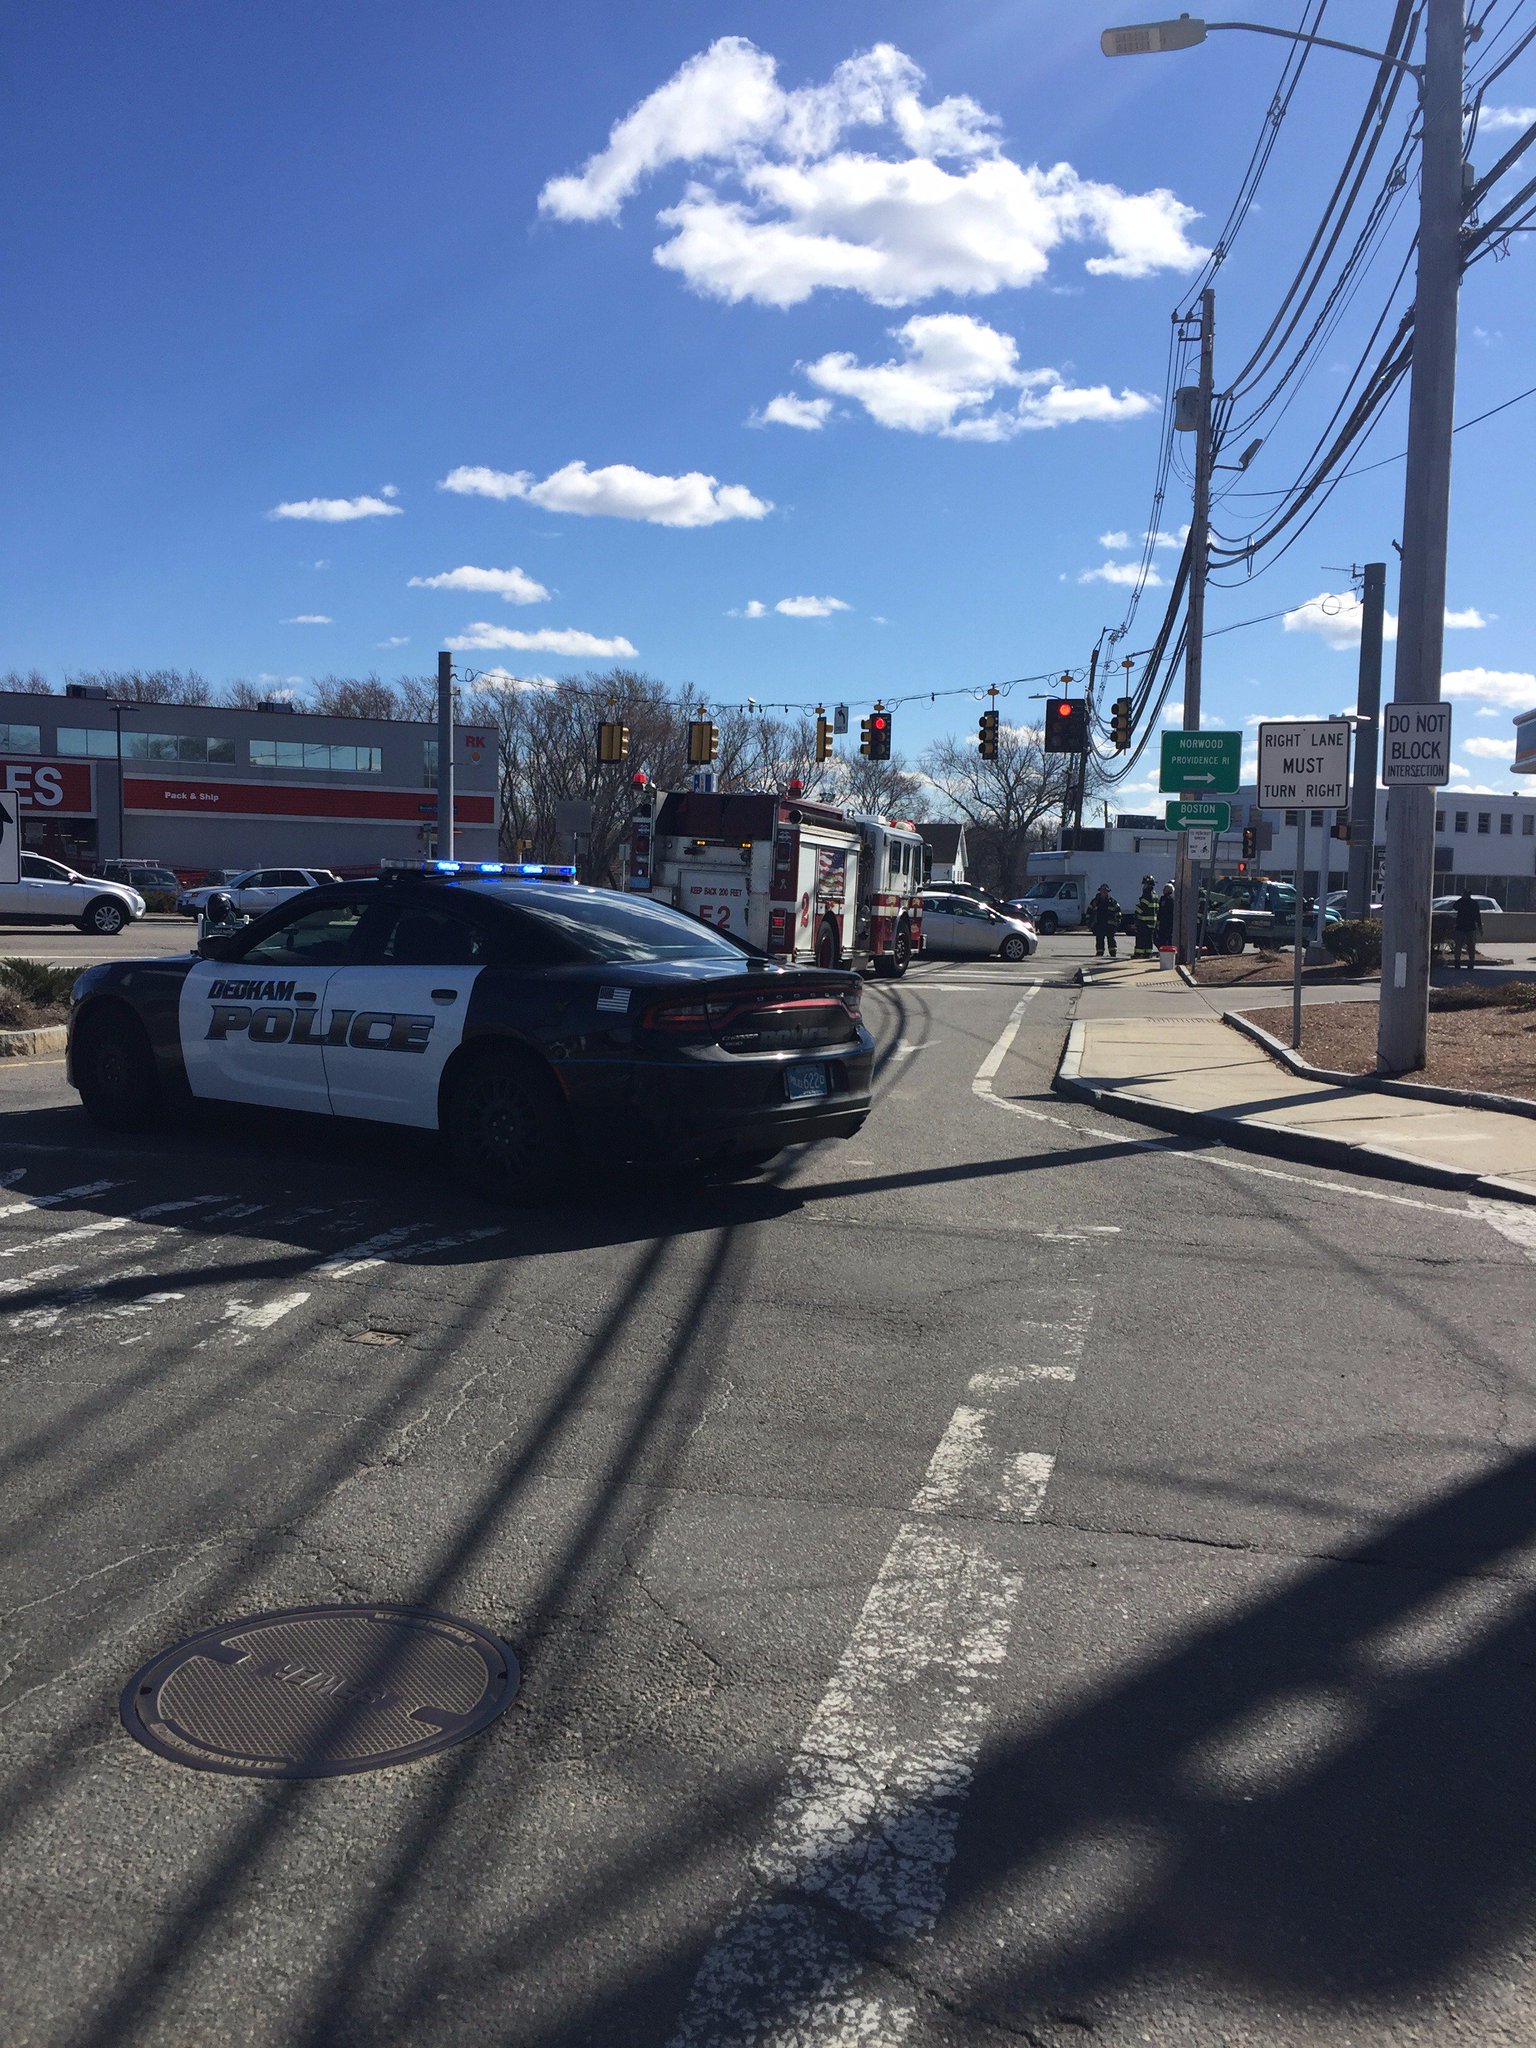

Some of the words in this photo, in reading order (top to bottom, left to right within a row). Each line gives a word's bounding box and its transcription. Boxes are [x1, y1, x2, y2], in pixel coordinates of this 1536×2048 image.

[1389, 715, 1410, 733] DO
[1416, 714, 1446, 732] NOT
[465, 735, 486, 748] RK
[1180, 739, 1223, 748] NORWOOD
[1265, 734, 1301, 747] RIGHT
[1311, 733, 1343, 746] LANE
[1391, 741, 1441, 759] BLOCK
[1171, 756, 1218, 764] PROVIDENCE
[1222, 756, 1229, 764] RI
[1283, 757, 1324, 774] MUST
[1387, 764, 1444, 777] INTERSECTION
[164, 791, 188, 799] Pack
[190, 792, 197, 800] &
[199, 793, 219, 802] Ship
[1264, 785, 1296, 797] TURN
[1306, 784, 1342, 797] RIGHT
[1180, 804, 1216, 813] BOSTON
[690, 886, 702, 894] KEEP
[704, 887, 717, 895] BACK
[719, 888, 729, 896] 200
[730, 888, 742, 896] FEET
[207, 979, 297, 1001] DEDHAM
[204, 1005, 436, 1054] POLICE
